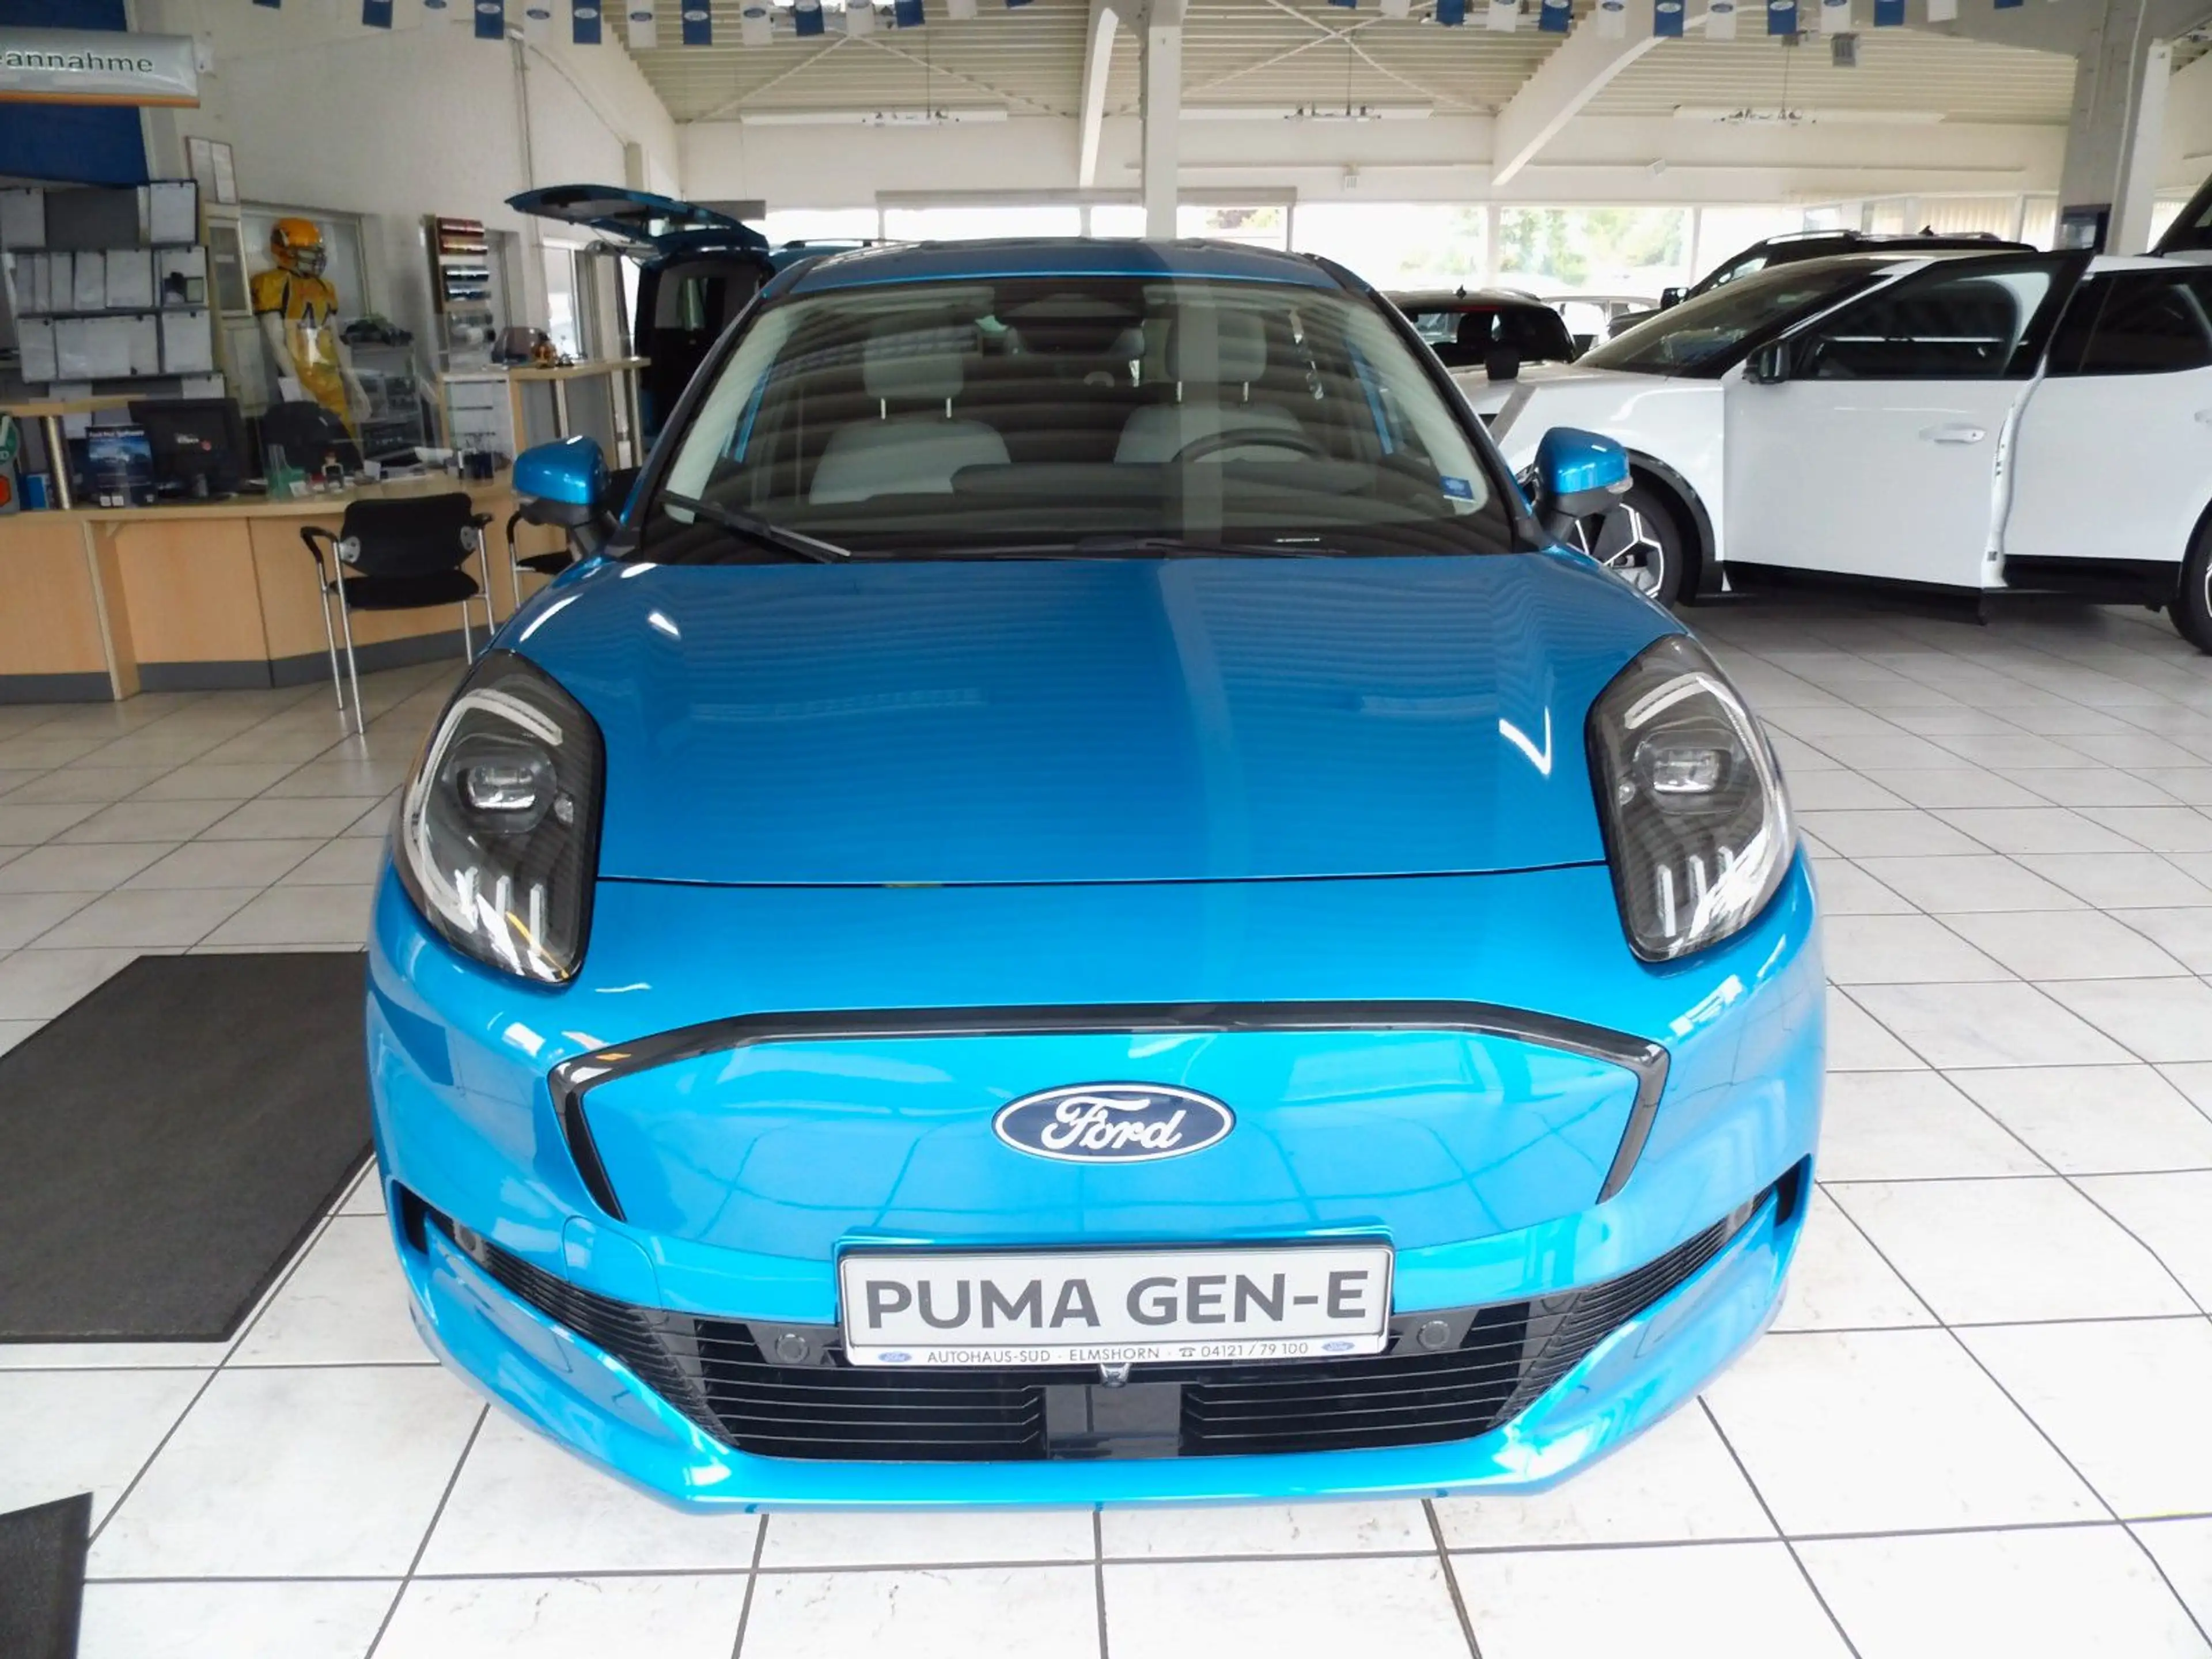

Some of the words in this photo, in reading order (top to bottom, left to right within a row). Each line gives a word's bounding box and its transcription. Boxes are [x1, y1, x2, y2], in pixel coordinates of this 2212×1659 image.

[0, 52, 153, 73] annahme
[1041, 1096, 1187, 1150] Ford
[865, 1278, 1101, 1329] PUMA
[1126, 1270, 1369, 1325] GEN-E
[1069, 1347, 1160, 1361] ELMSHORN
[1281, 1342, 1309, 1354] 100
